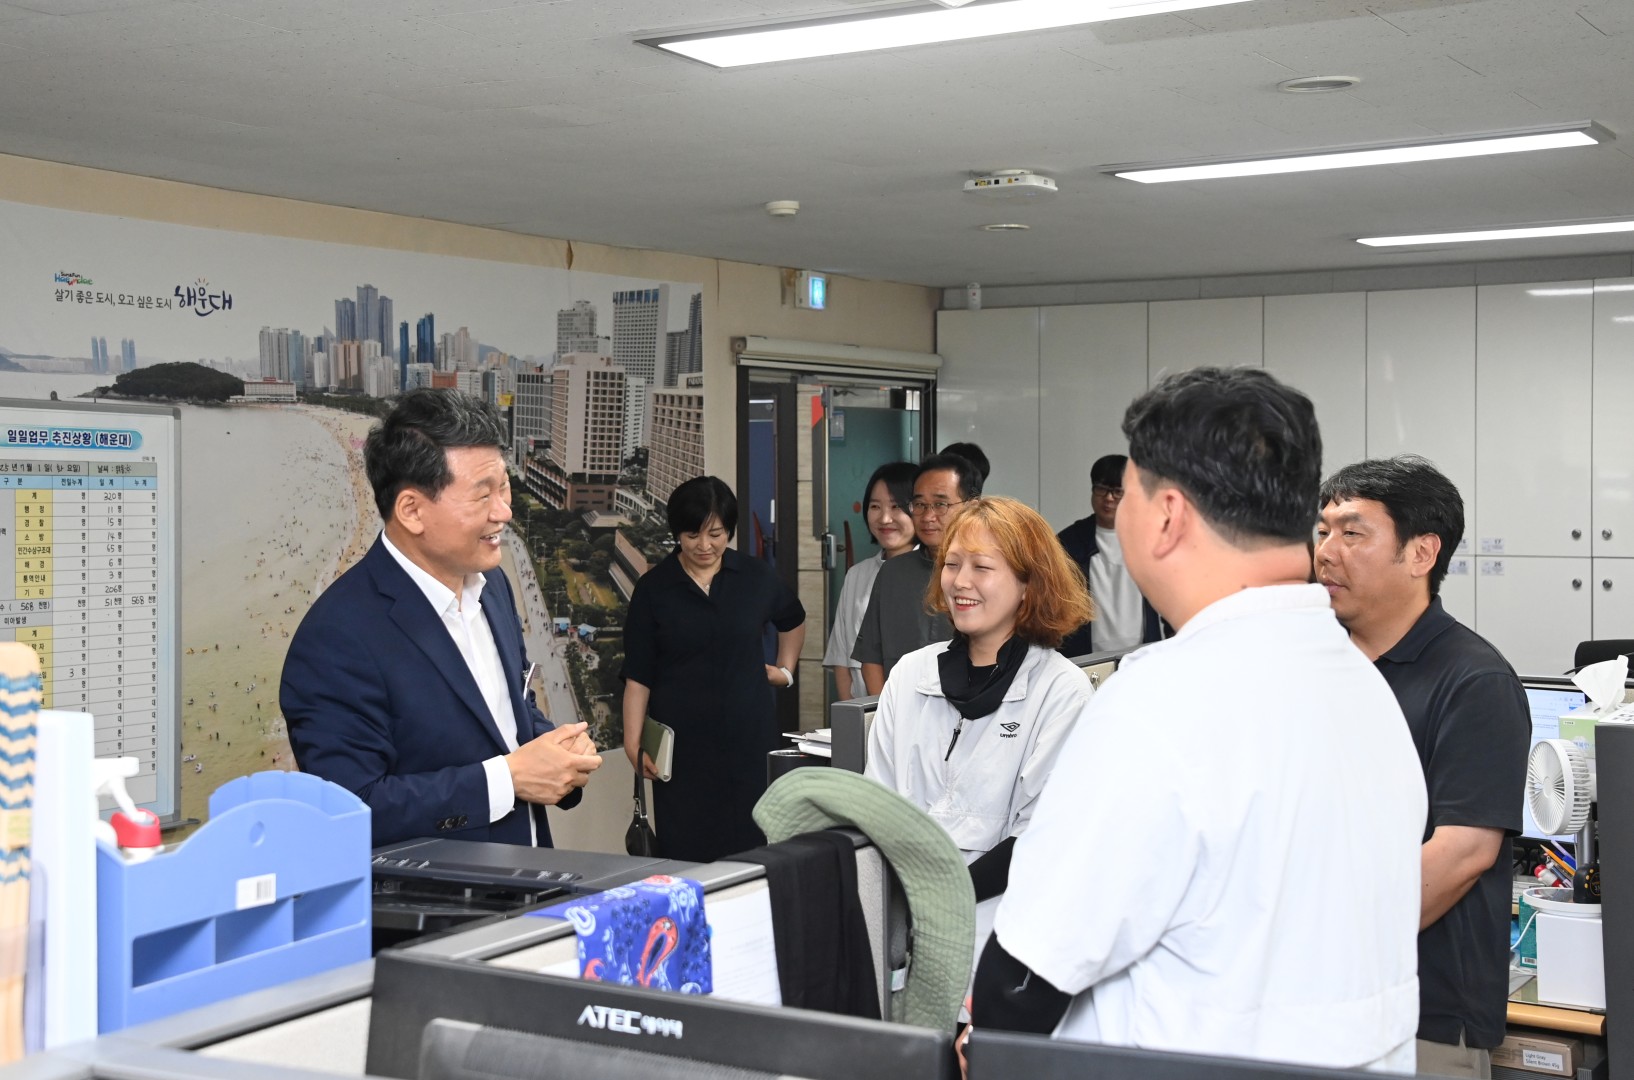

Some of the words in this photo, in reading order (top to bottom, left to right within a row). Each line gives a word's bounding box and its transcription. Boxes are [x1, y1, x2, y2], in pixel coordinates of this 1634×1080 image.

[54, 289, 73, 302] 살기
[76, 290, 93, 303] 좋은
[118, 294, 134, 306] 오고
[137, 296, 153, 308] 싶은
[156, 298, 172, 310] 도시
[174, 285, 232, 317] 해운대
[7, 429, 48, 444] 일일업무
[52, 431, 91, 445] 추진상황
[95, 433, 132, 446] (해운대)
[577, 1005, 641, 1034] ATEC
